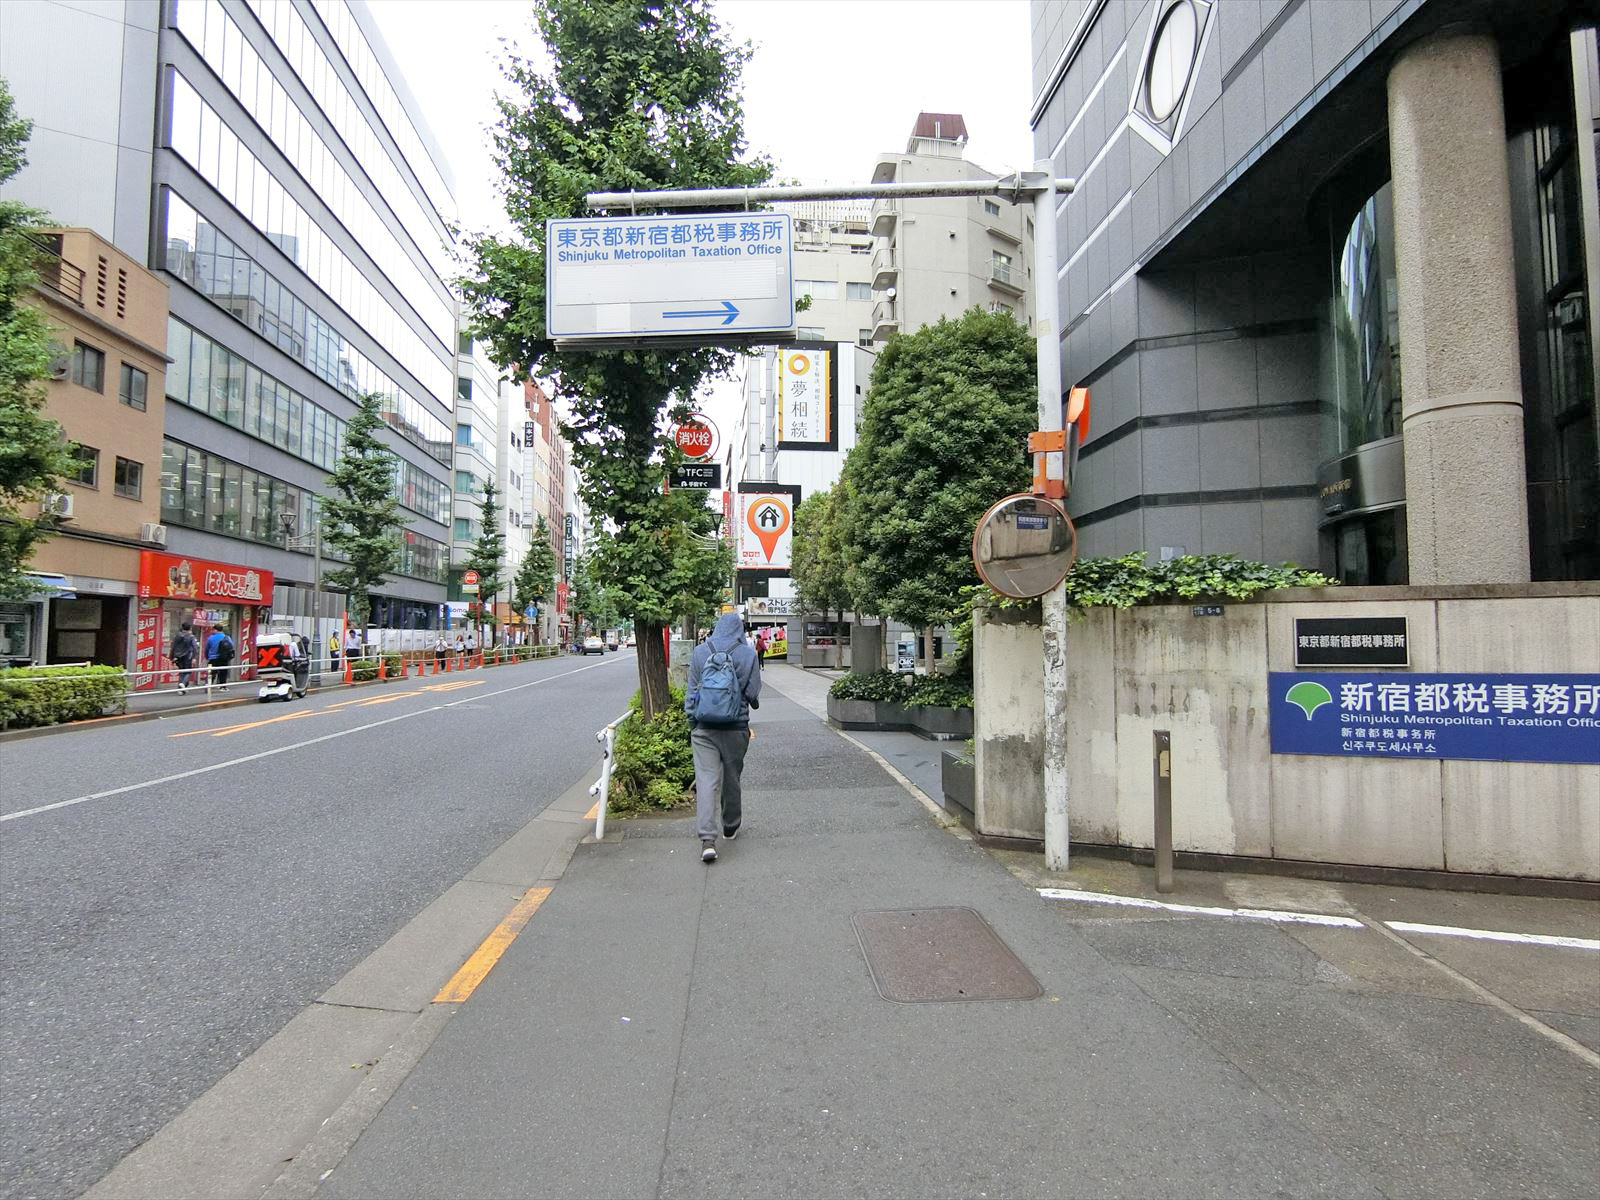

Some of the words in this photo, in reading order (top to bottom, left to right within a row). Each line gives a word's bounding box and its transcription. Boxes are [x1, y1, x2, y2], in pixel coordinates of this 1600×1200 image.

[557, 221, 783, 248] 東京都新宿都税事務所
[558, 250, 609, 263] Shinjuku
[614, 246, 686, 260] Metropolitan
[691, 245, 741, 257] Taxation
[747, 244, 783, 256] Office
[790, 380, 808, 439] 夢相続
[679, 431, 710, 446] 消火栓
[686, 468, 703, 477] TFC
[1298, 634, 1405, 648] 東京都新宿都税事務所
[1340, 682, 1600, 714] 新宿都税事務所
[1340, 713, 1399, 725] Shinjuku
[1404, 715, 1492, 727] Metropolitan
[1497, 716, 1562, 727] Taxation
[1341, 727, 1436, 740] 新宿都税事务所
[1342, 740, 1437, 753] 신주쿠도세사무소
